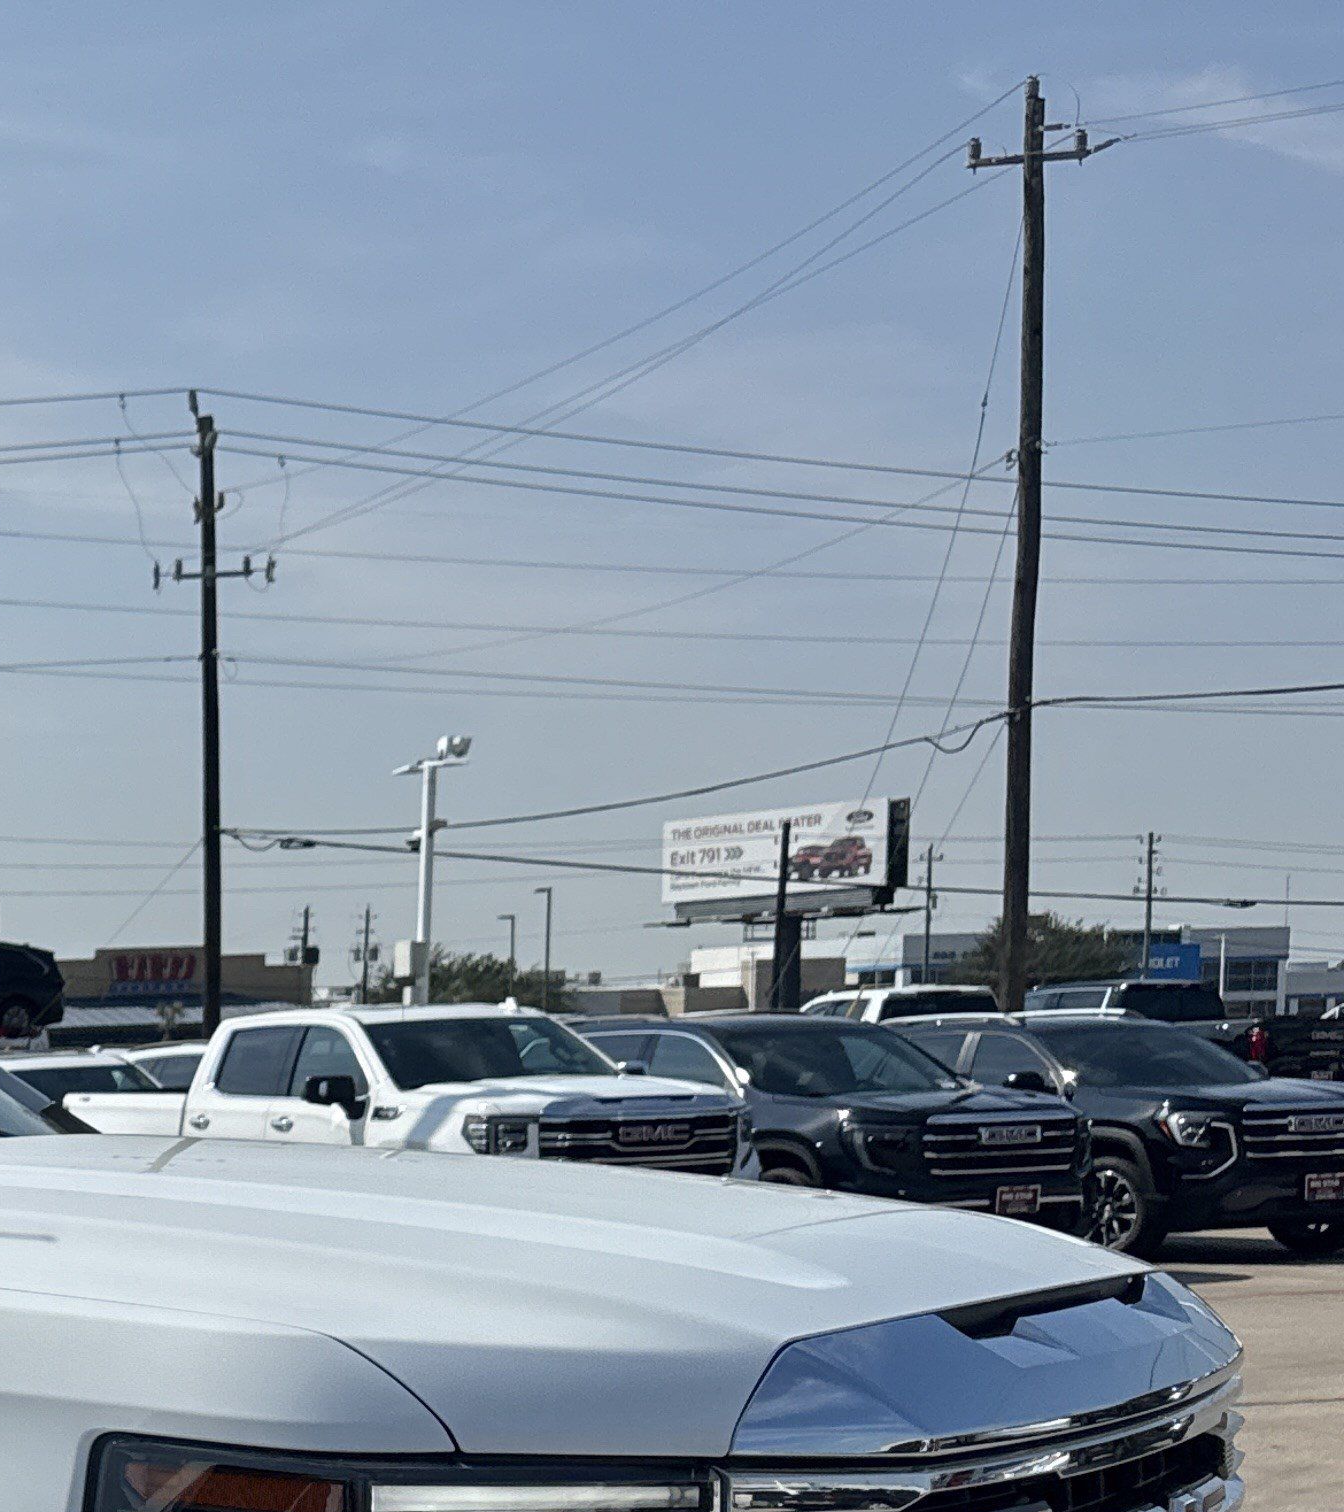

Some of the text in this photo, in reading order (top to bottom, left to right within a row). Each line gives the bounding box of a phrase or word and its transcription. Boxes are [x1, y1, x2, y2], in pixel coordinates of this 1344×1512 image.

[672, 828, 691, 841] THE
[694, 822, 743, 839] ORIGINAL
[747, 819, 776, 833] DEAL
[670, 847, 721, 867] Exit 791
[619, 1124, 690, 1143] GMC
